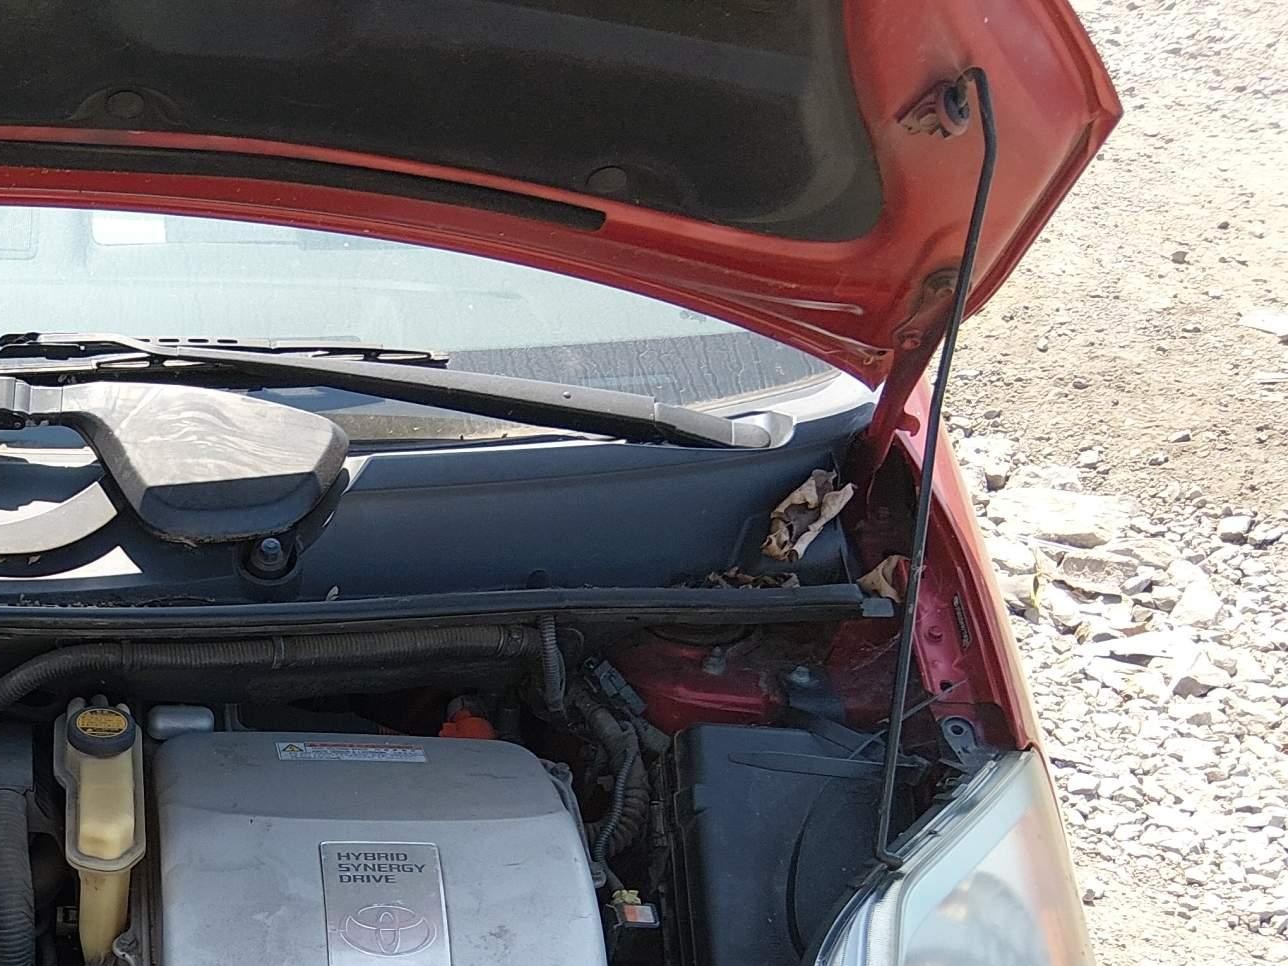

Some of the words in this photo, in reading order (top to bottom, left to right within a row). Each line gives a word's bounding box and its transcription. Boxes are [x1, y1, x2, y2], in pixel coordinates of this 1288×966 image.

[337, 852, 408, 861] HYBRID
[337, 863, 425, 873] SYNERGY
[339, 874, 397, 883] DRIVE
